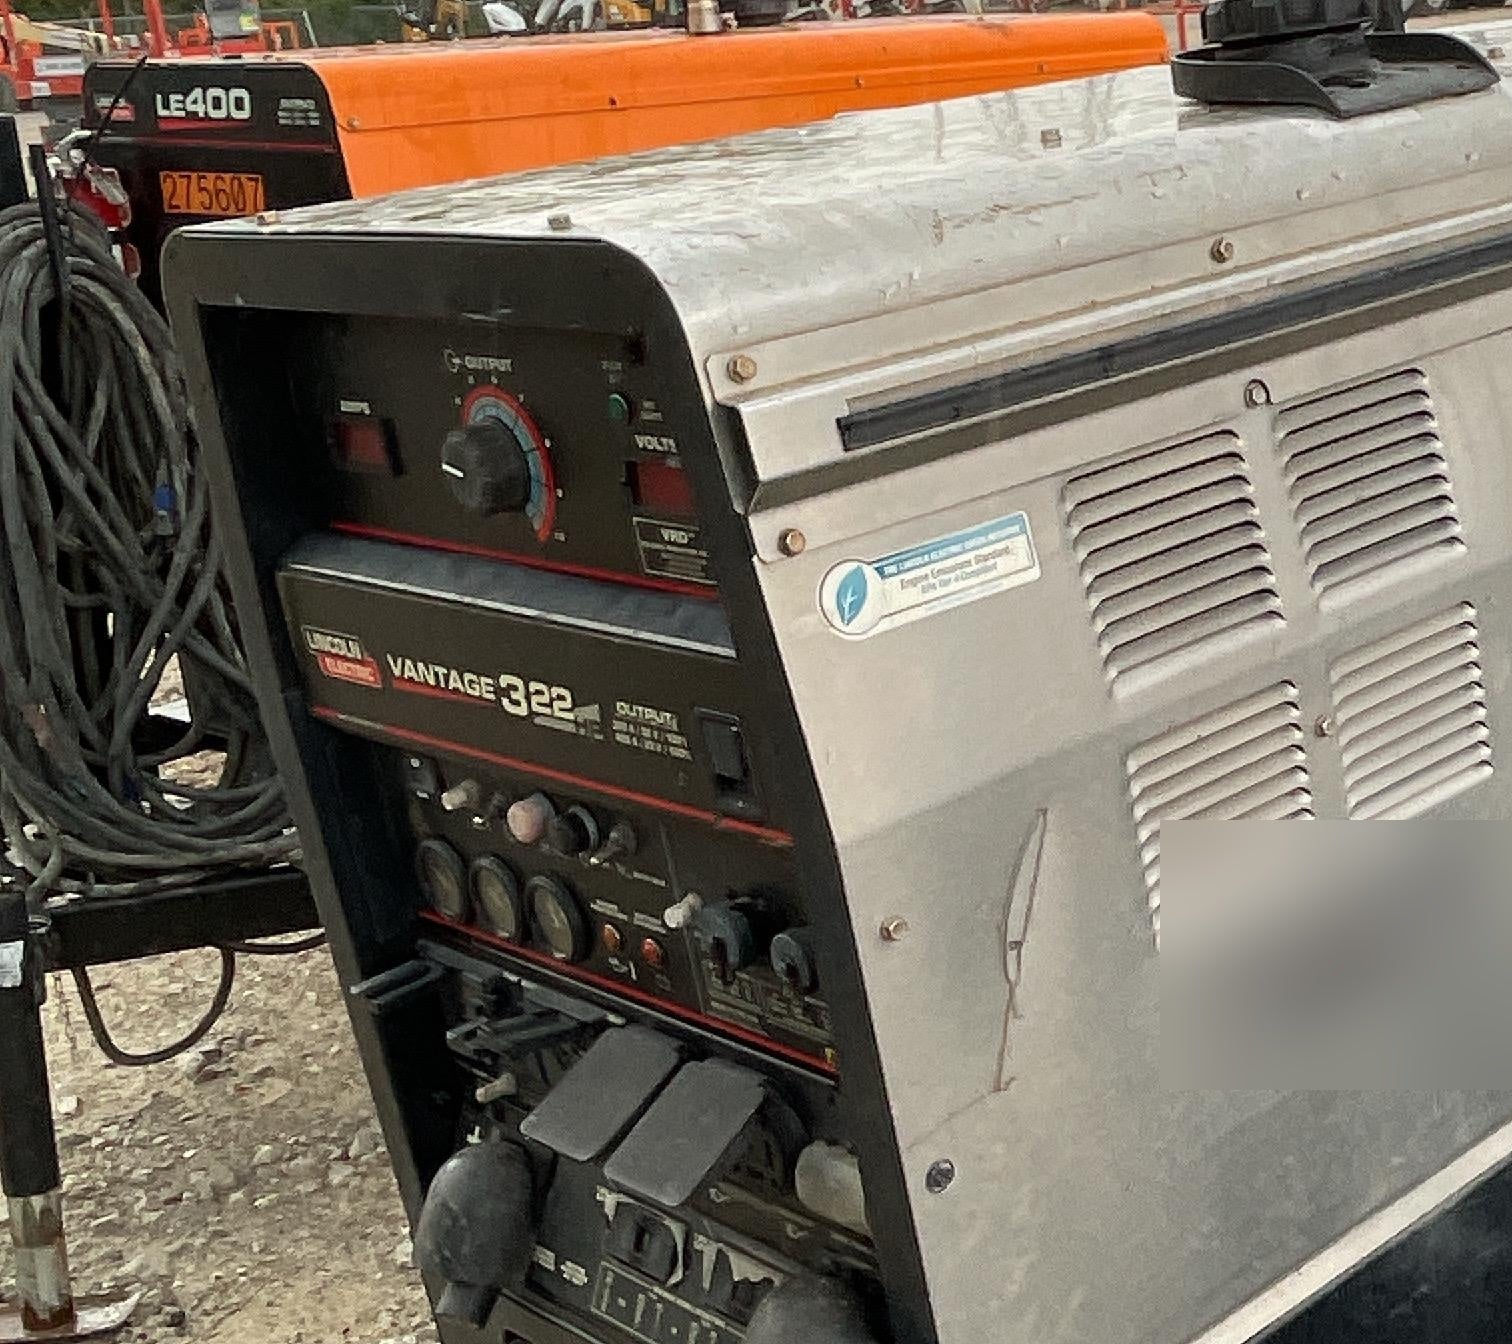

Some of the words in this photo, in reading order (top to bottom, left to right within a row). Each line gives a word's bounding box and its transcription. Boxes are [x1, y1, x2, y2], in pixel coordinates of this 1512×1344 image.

[155, 86, 251, 120] LE400
[162, 174, 261, 212] 275607
[386, 652, 496, 701] VANTAGE
[498, 673, 575, 721] 322
